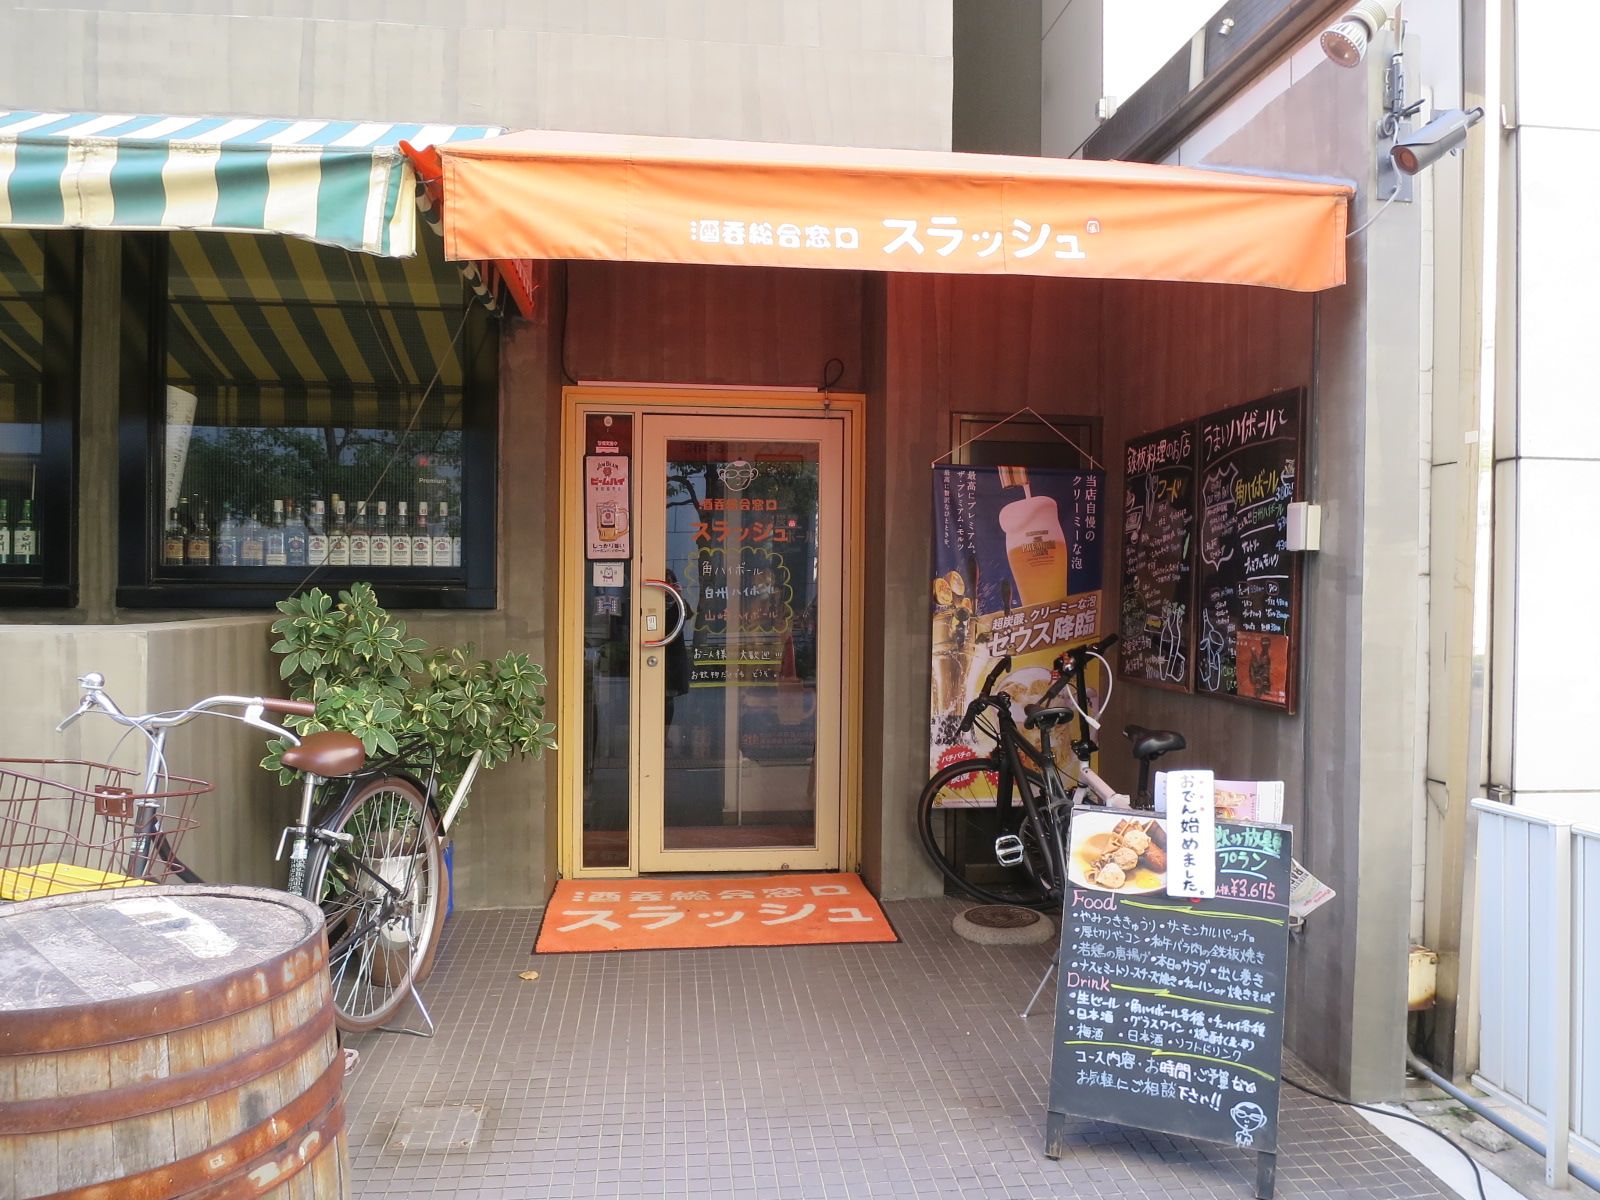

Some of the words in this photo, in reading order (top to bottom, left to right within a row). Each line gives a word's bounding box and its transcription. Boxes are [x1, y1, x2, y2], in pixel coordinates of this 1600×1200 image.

[882, 216, 1086, 259] スラッシュ
[1157, 479, 1182, 503] フード
[1085, 475, 1097, 541] 当店自慢の
[689, 520, 788, 542] スラッシュ
[1071, 475, 1083, 569] クリーミーな泡
[987, 609, 1097, 657] ゼウス降臨
[1180, 775, 1205, 896] おでん始めました。
[1219, 851, 1268, 871] プラン
[1071, 889, 1117, 911] Food
[556, 903, 875, 933] スラッシュ
[1067, 971, 1110, 992] Drink
[1077, 991, 1120, 1009] 生ビール
[1076, 1008, 1114, 1024] 日本酒
[1130, 1015, 1184, 1033] グラスワイン
[1076, 1023, 1104, 1041] 梅酒
[1127, 1029, 1164, 1047] 日本酒
[1174, 1038, 1242, 1062] ソフトドリンク
